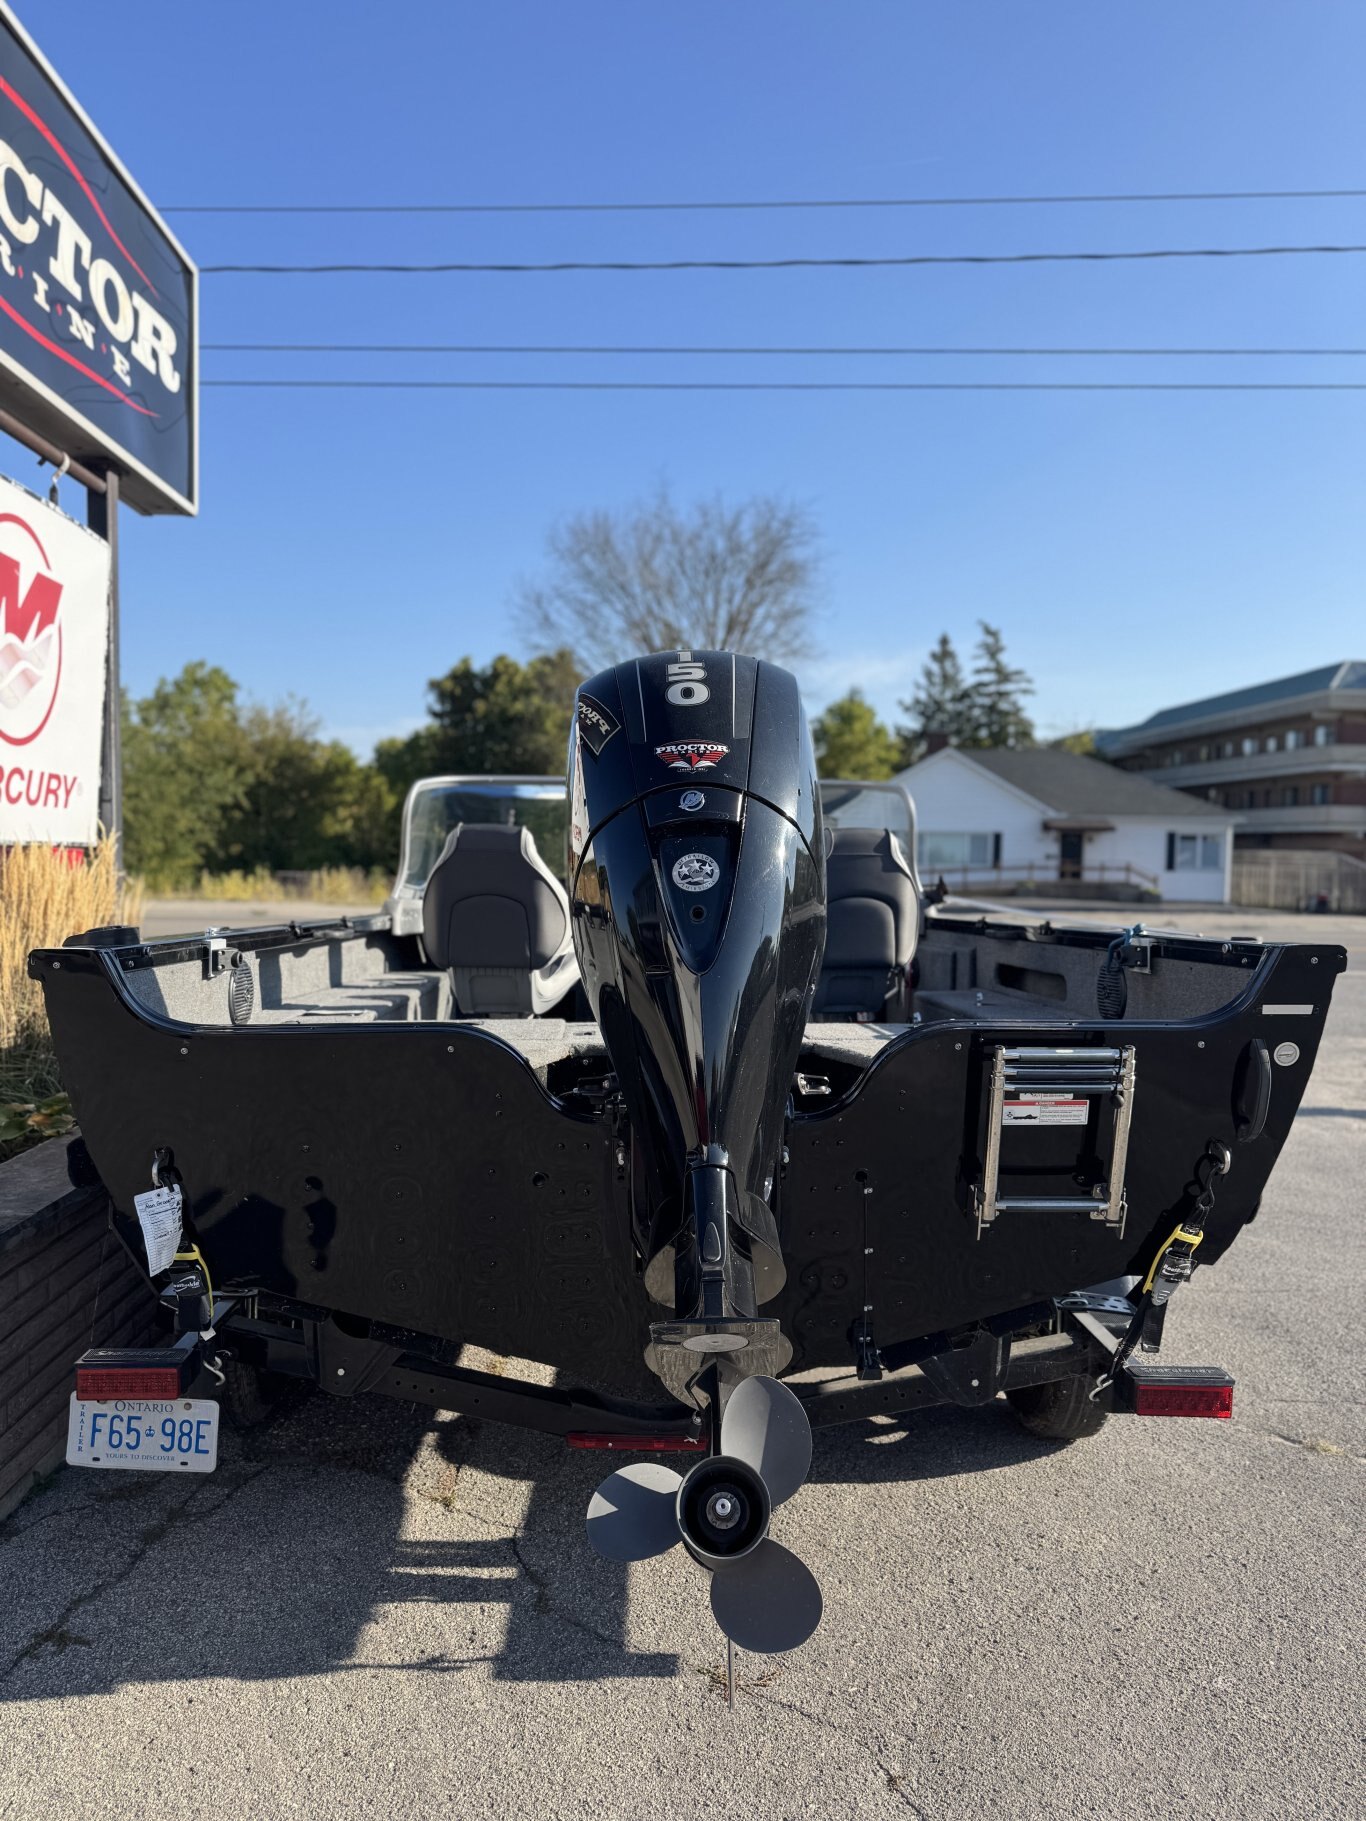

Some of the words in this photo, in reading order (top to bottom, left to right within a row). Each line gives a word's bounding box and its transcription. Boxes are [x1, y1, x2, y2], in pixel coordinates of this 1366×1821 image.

[665, 651, 711, 706] 150
[655, 743, 729, 754] PROCTOR
[77, 1404, 86, 1452] TRAILER
[90, 1413, 142, 1450] F65
[160, 1417, 211, 1454] 98E
